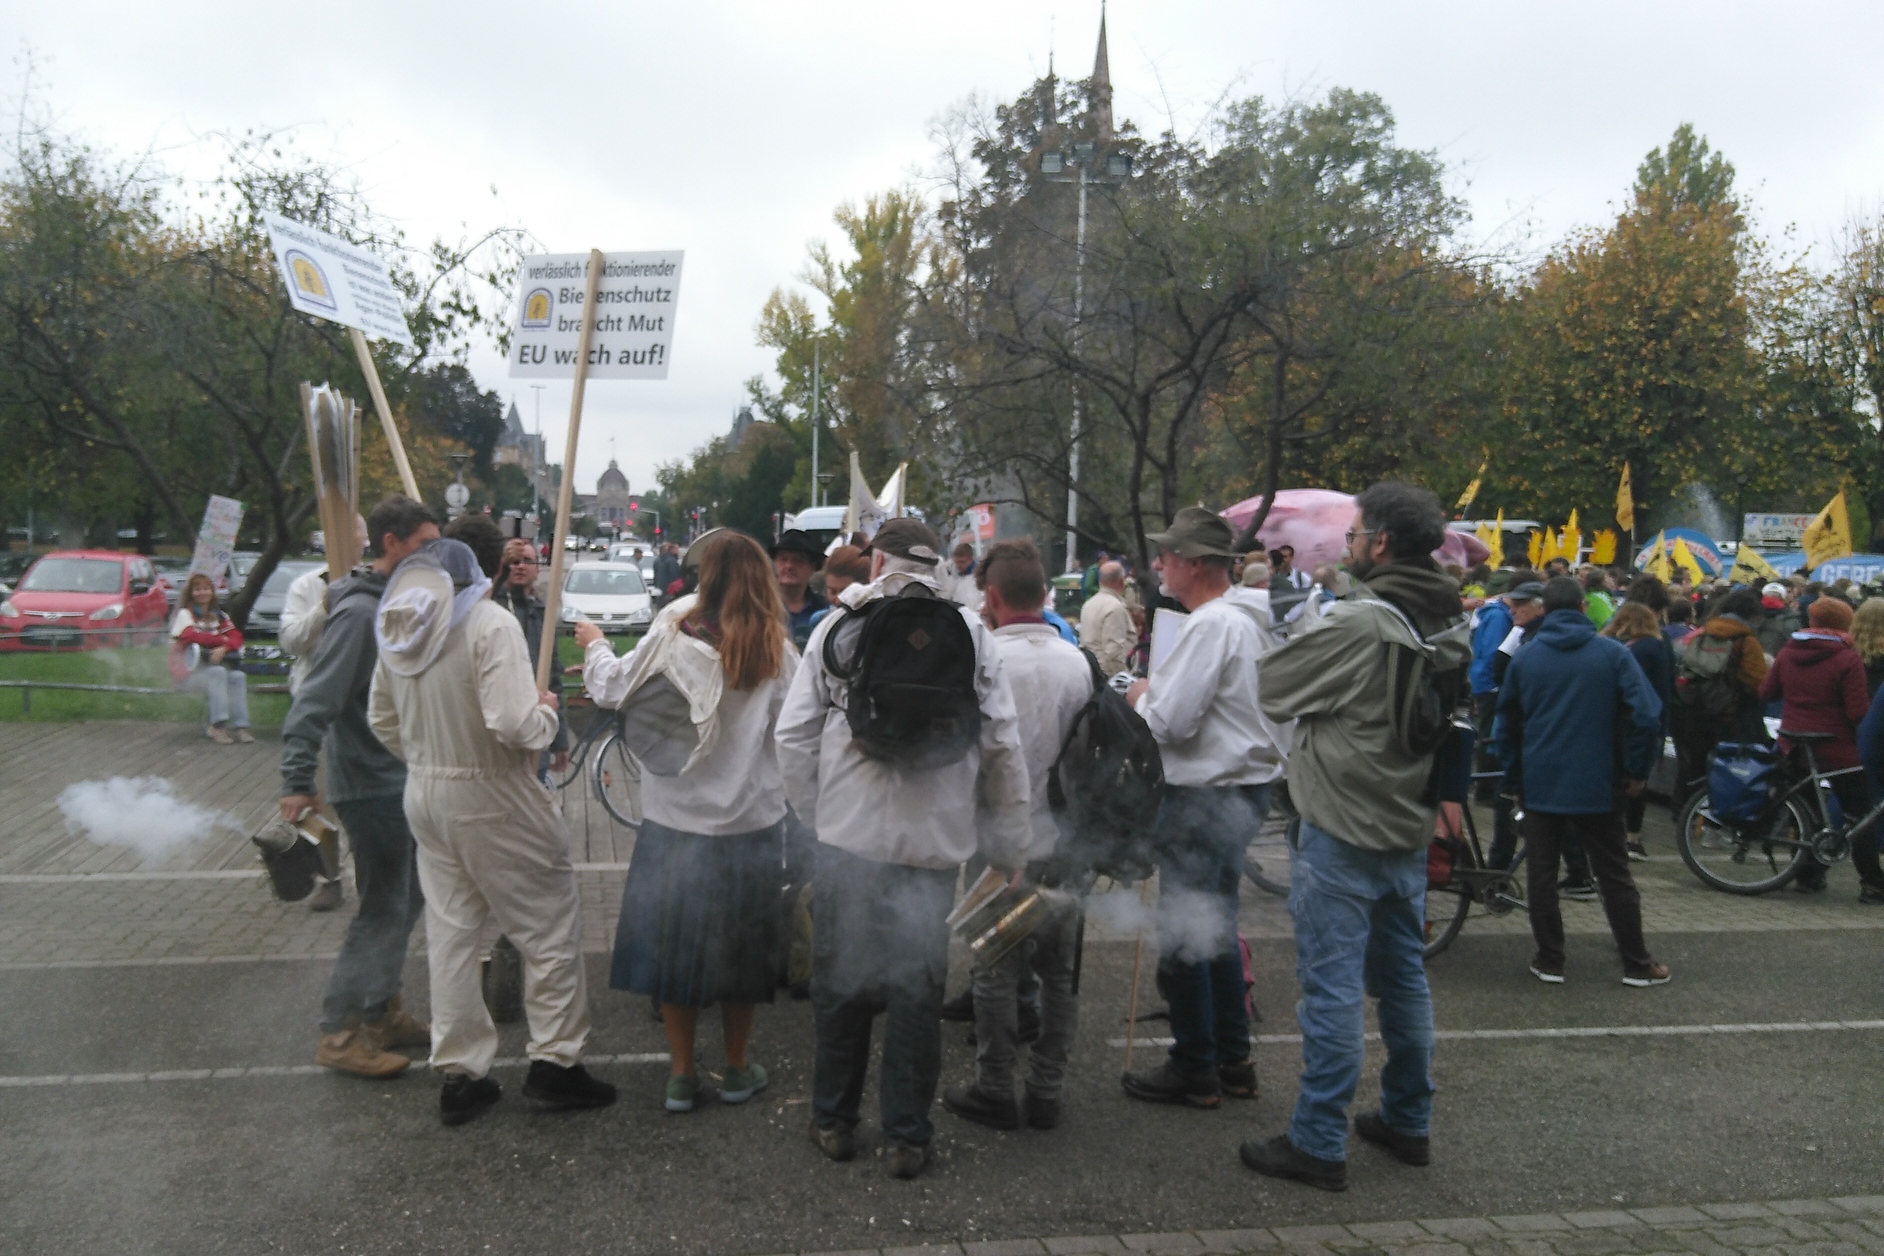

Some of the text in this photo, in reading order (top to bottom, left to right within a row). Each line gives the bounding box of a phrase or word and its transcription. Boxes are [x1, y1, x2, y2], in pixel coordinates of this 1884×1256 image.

[529, 259, 676, 279] verlässlich fktionierender
[559, 285, 672, 304] Bieenschutz
[558, 315, 665, 332] bracht Mut
[519, 345, 547, 364] EU
[618, 344, 665, 365] auf!
